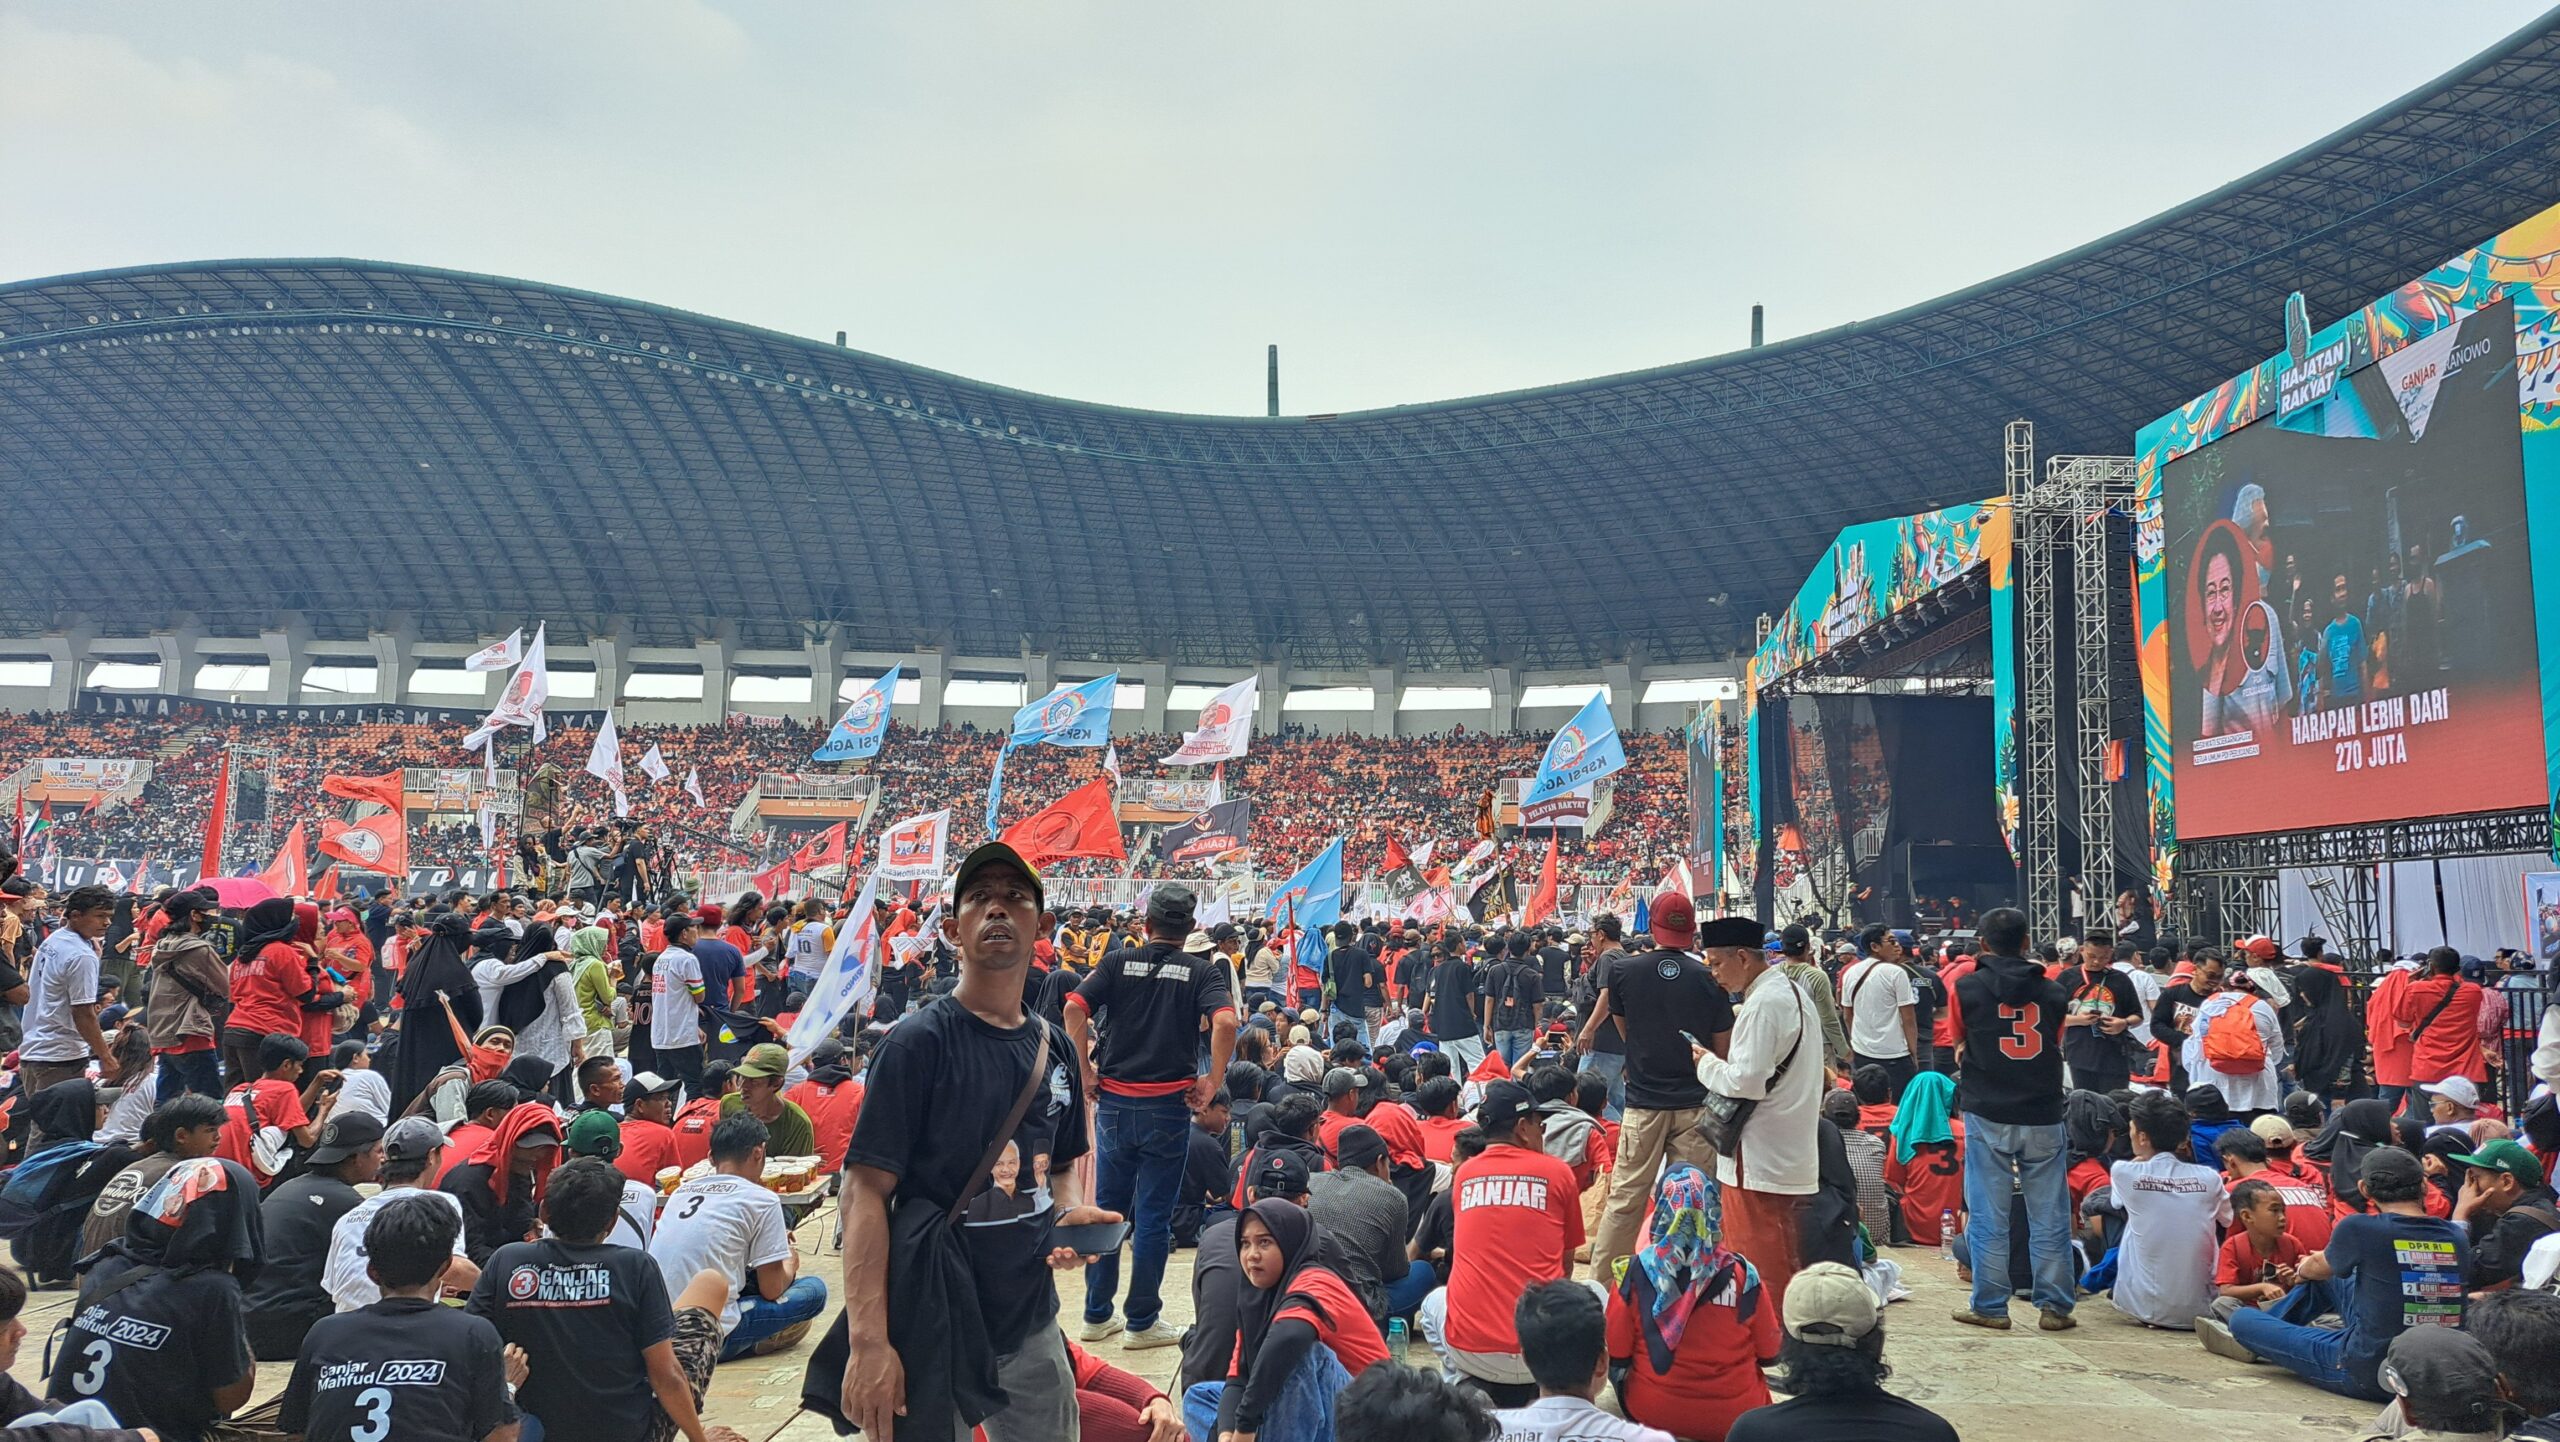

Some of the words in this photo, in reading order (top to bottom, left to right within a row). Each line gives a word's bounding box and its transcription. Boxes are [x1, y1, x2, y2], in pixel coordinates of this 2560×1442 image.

[2279, 341, 2345, 393] HAJATAN
[2401, 363, 2436, 391] GANJAR
[2444, 337, 2491, 372] RANOWO
[2280, 371, 2335, 414] RAKYAT
[2291, 706, 2356, 746] HARAPAN
[2361, 696, 2405, 734] LEBIH
[2410, 687, 2449, 725] DARI
[2335, 740, 2363, 772] 270
[2367, 733, 2408, 768] JUTA
[1528, 803, 1557, 820] PELAYAN
[1558, 801, 1586, 810] RAKYAT
[1998, 1000, 2043, 1061] 3
[1929, 1139, 1960, 1176] 3
[621, 1192, 636, 1200] 24
[706, 1184, 731, 1193] 2024
[1461, 1181, 1547, 1212] GANJAR
[678, 1195, 705, 1220] 3
[346, 1216, 371, 1225] Mahfu
[2408, 1241, 2430, 1250] DPR
[515, 1271, 535, 1295] 3
[540, 1269, 610, 1287] GANJAR
[2406, 1284, 2413, 1294] 2
[538, 1283, 610, 1301] MAHFUD
[82, 1304, 110, 1320] njar
[2405, 1315, 2414, 1325] 3
[74, 1317, 109, 1336] ahfud
[112, 1321, 162, 1345] 2024
[72, 1339, 113, 1395] 3
[317, 1371, 376, 1393] Mahfud
[384, 1363, 438, 1382] 2024
[320, 1360, 369, 1379] Ganjar
[350, 1387, 393, 1442] 3
